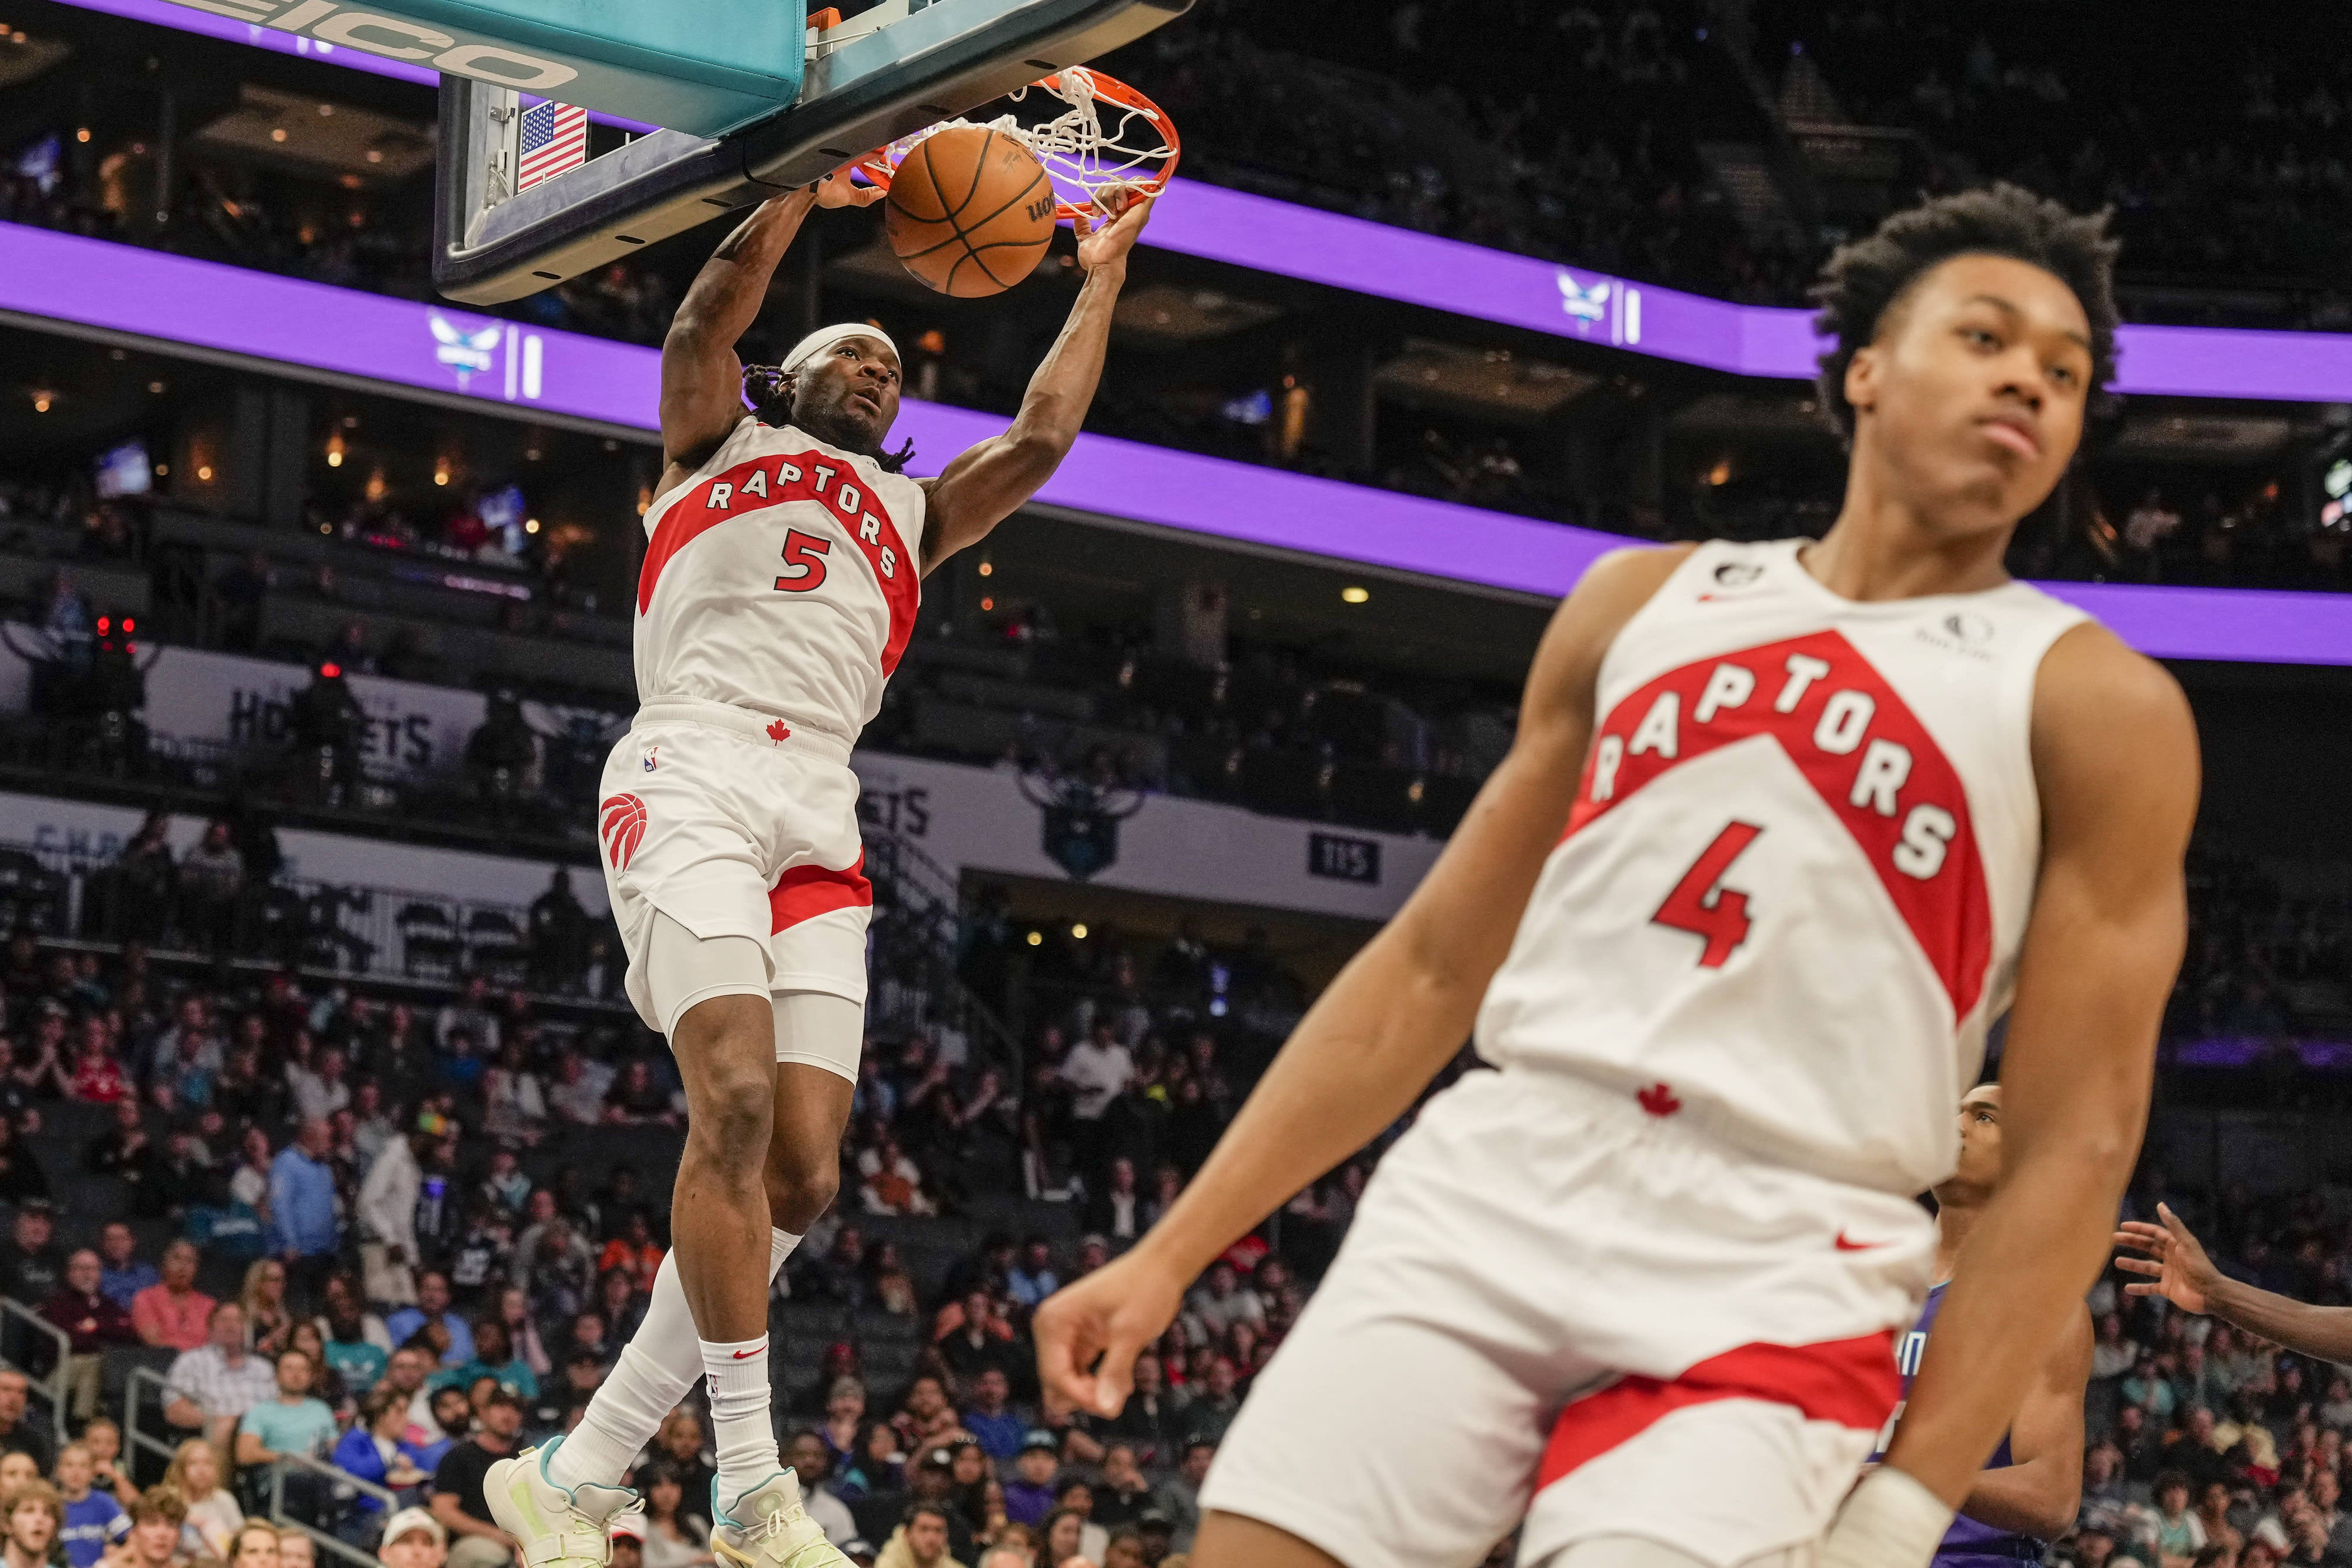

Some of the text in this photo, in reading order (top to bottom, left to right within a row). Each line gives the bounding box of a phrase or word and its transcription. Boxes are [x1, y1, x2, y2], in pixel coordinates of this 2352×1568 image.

[706, 461, 897, 579] RAPTORS
[773, 528, 831, 592] 5
[1590, 651, 1957, 880] RAPTORS
[1650, 820, 1765, 969] 4
